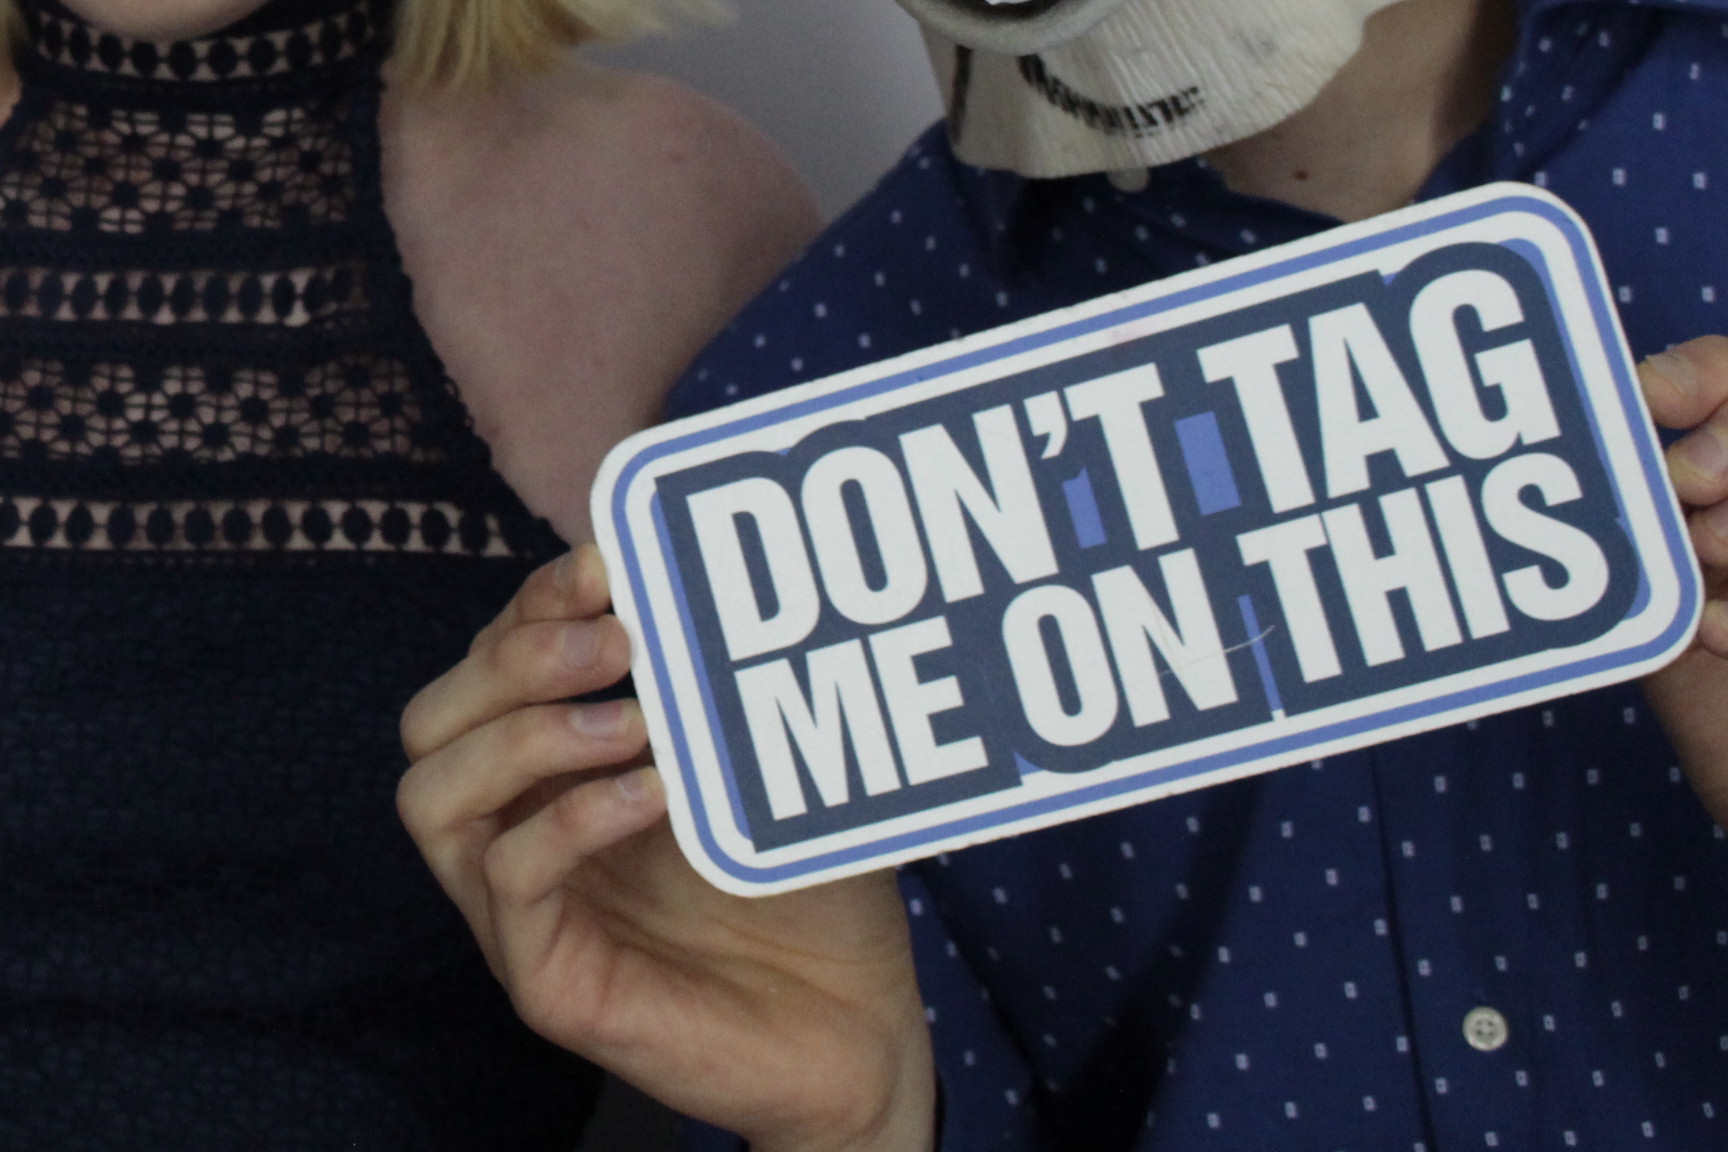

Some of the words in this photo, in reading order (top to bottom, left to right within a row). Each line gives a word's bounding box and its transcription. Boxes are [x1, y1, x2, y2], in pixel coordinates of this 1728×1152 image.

[687, 363, 1180, 661] DON'T
[1197, 269, 1562, 515] TAG
[734, 621, 988, 820] ME
[1002, 548, 1239, 746] ON
[1236, 452, 1611, 684] THIS
